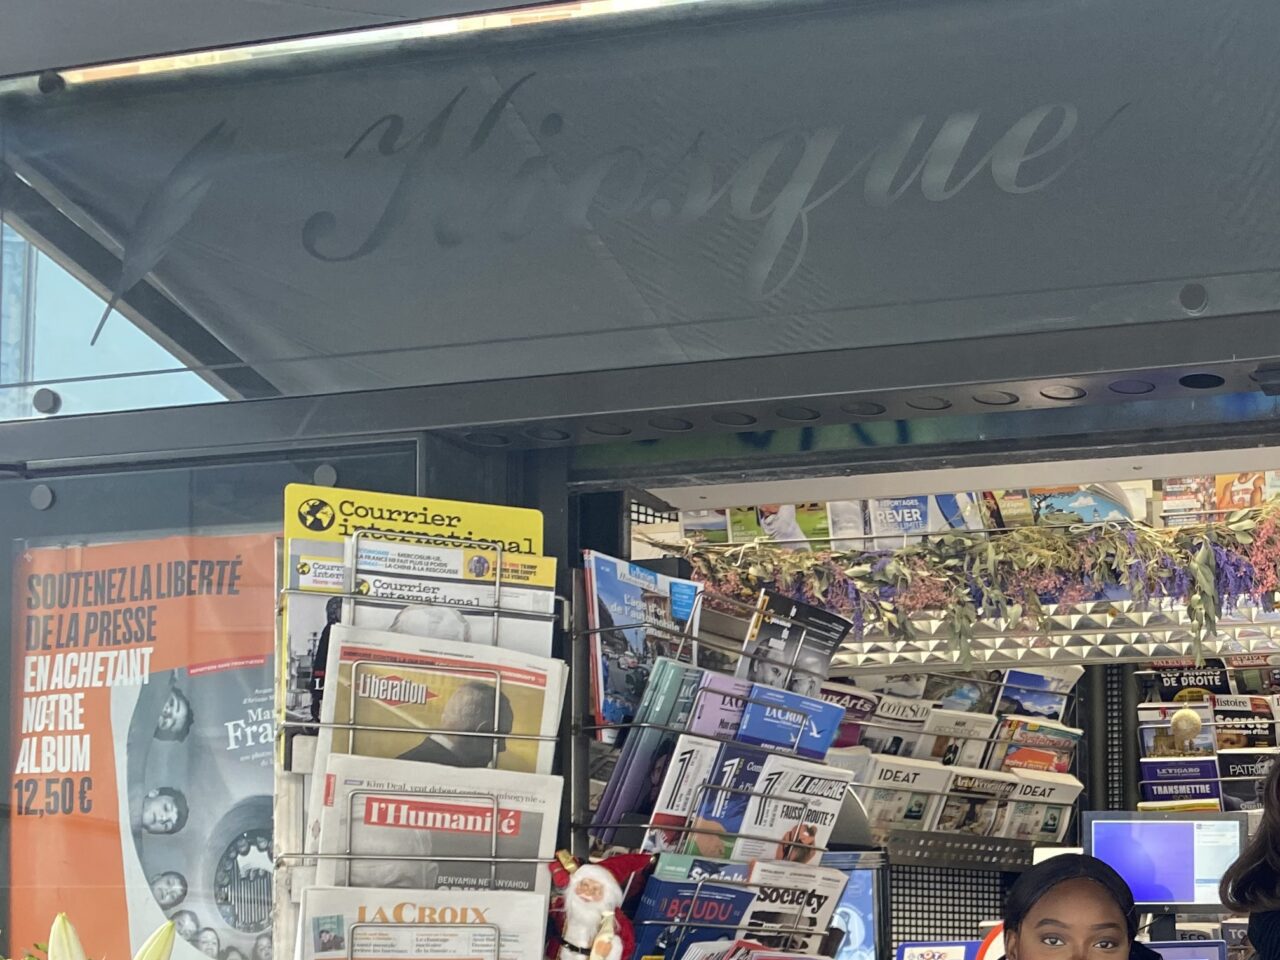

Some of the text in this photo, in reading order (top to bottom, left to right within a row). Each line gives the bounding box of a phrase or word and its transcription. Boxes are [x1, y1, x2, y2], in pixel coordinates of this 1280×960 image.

[338, 499, 461, 529] Courrier
[338, 518, 536, 556] international
[27, 555, 243, 611] SOUTENEZ LA LIBERTÉ
[373, 579, 441, 595] Courrier
[26, 605, 157, 651] DE LA PRESSE
[24, 654, 51, 693] EN
[50, 647, 154, 689] ACHETANT
[1163, 675, 1222, 688] DE DROITE
[22, 693, 85, 734] NOTRE
[14, 734, 91, 775] ALBUM
[791, 774, 849, 800] LA GAUCHE
[878, 768, 920, 784] IDEAT
[1019, 782, 1056, 799] IDEAT
[1152, 784, 1211, 796] TRANSMETTRE
[14, 776, 93, 818] 12,50 €
[437, 875, 475, 885] BENYAMIN
